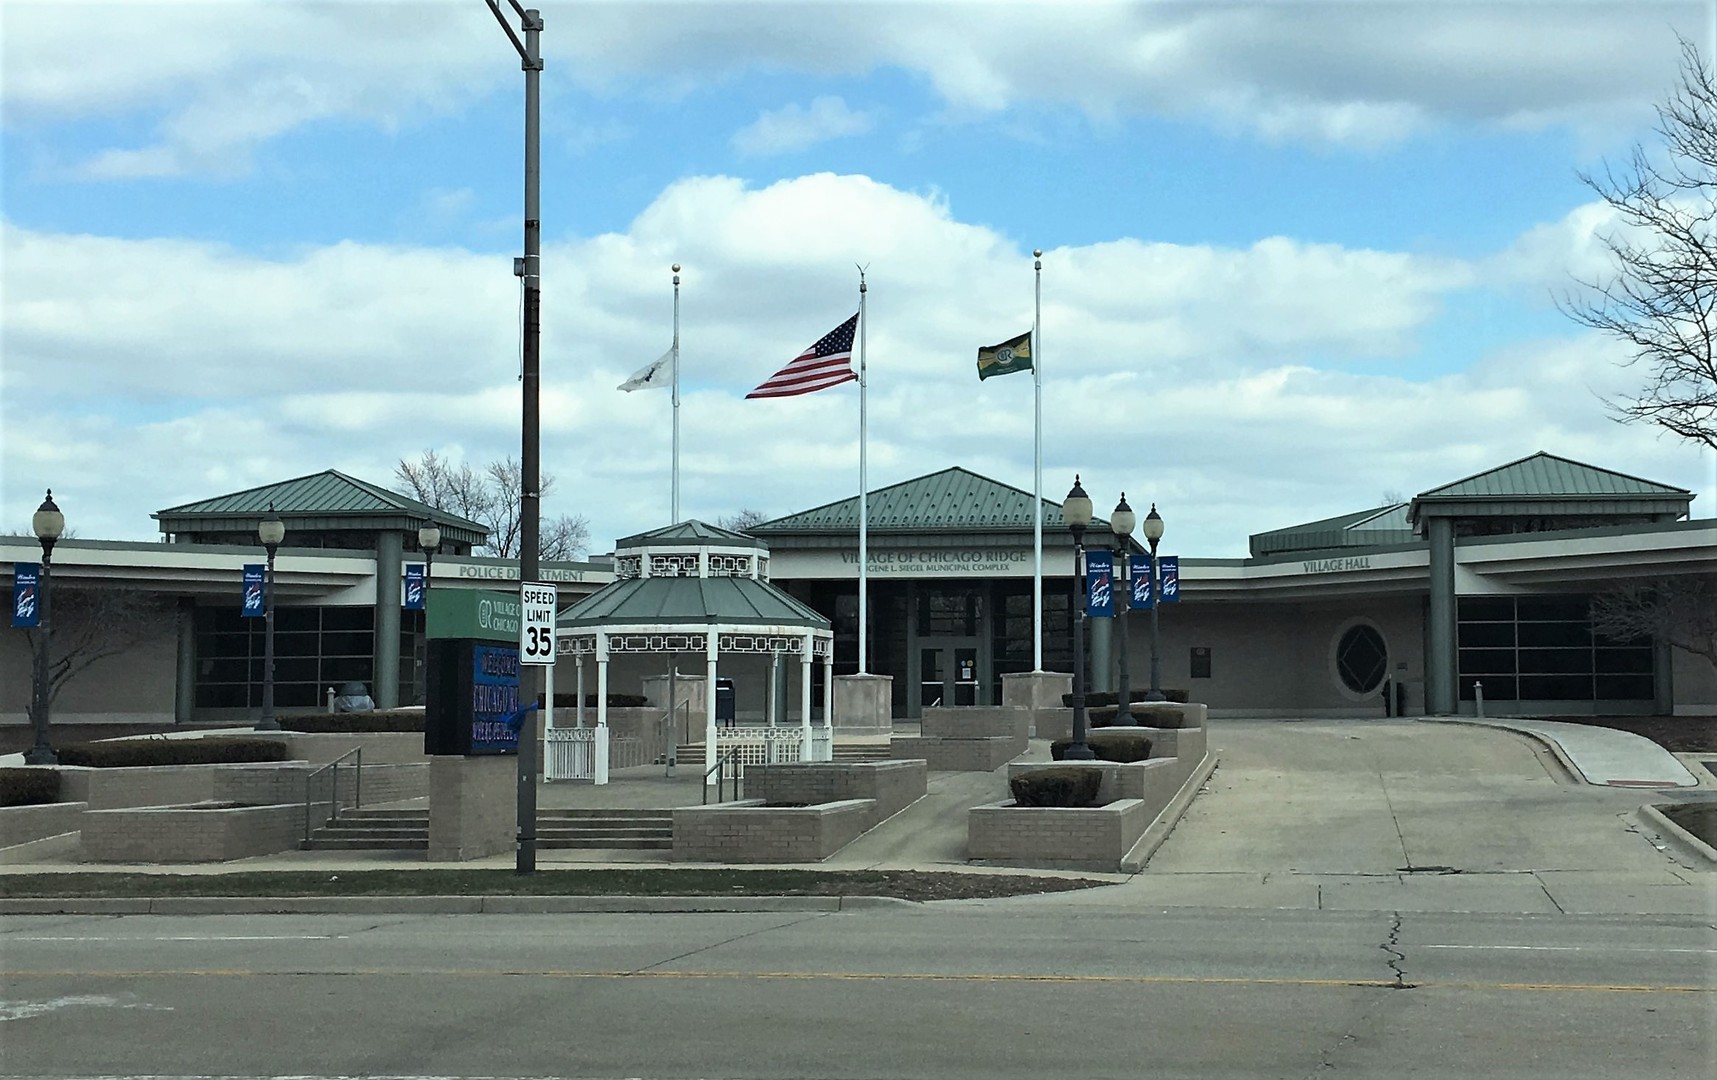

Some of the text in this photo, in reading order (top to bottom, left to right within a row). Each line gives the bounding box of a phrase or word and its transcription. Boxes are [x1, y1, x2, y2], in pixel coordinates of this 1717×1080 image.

[898, 552, 915, 563] OF
[919, 551, 982, 563] CHICAGO
[985, 550, 1027, 562] RIDGE
[899, 564, 924, 572] SIEGEL
[926, 563, 970, 572] MUNICIPAL
[972, 563, 1010, 571] COMPLEX
[1303, 557, 1371, 573] VILLAGE HALL
[460, 566, 503, 579] POLICE
[524, 591, 554, 605] SPEED
[493, 601, 515, 615] VILLAGE
[527, 610, 551, 623] LIMIT
[493, 618, 518, 632] CHICAGO
[525, 627, 551, 656] 35
[474, 685, 508, 712] CHICAGO
